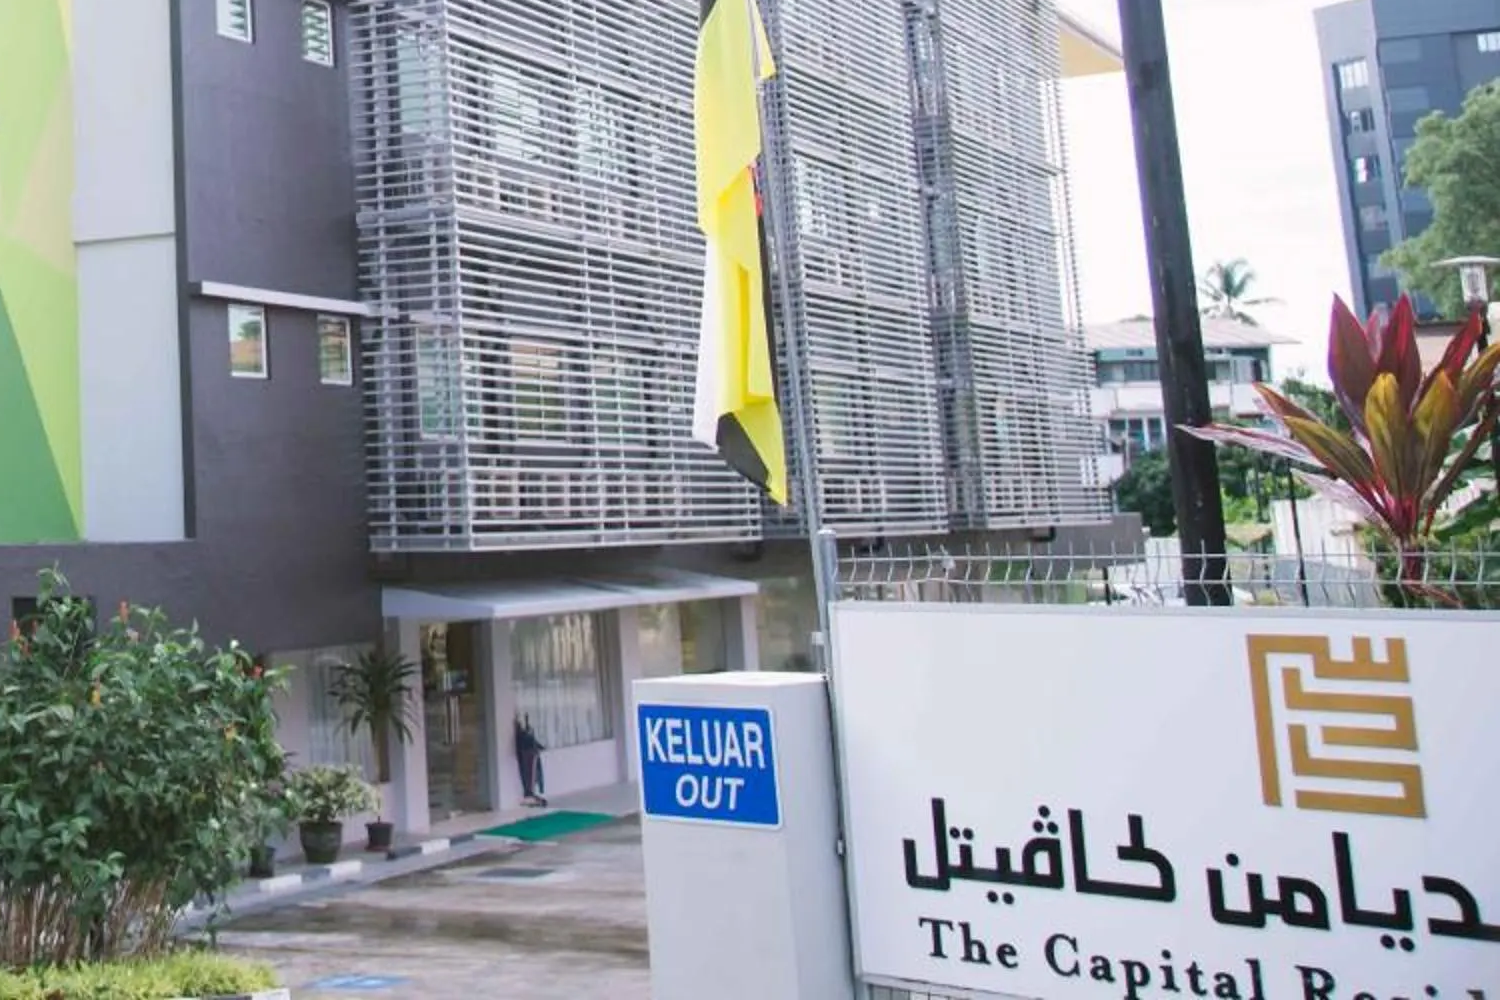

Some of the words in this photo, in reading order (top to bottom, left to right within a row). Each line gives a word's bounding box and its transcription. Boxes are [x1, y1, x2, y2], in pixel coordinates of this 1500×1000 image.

[645, 717, 766, 769] KELUAR
[675, 773, 745, 811] OUT
[918, 917, 1019, 969] The
[1044, 933, 1261, 1000] Capital
